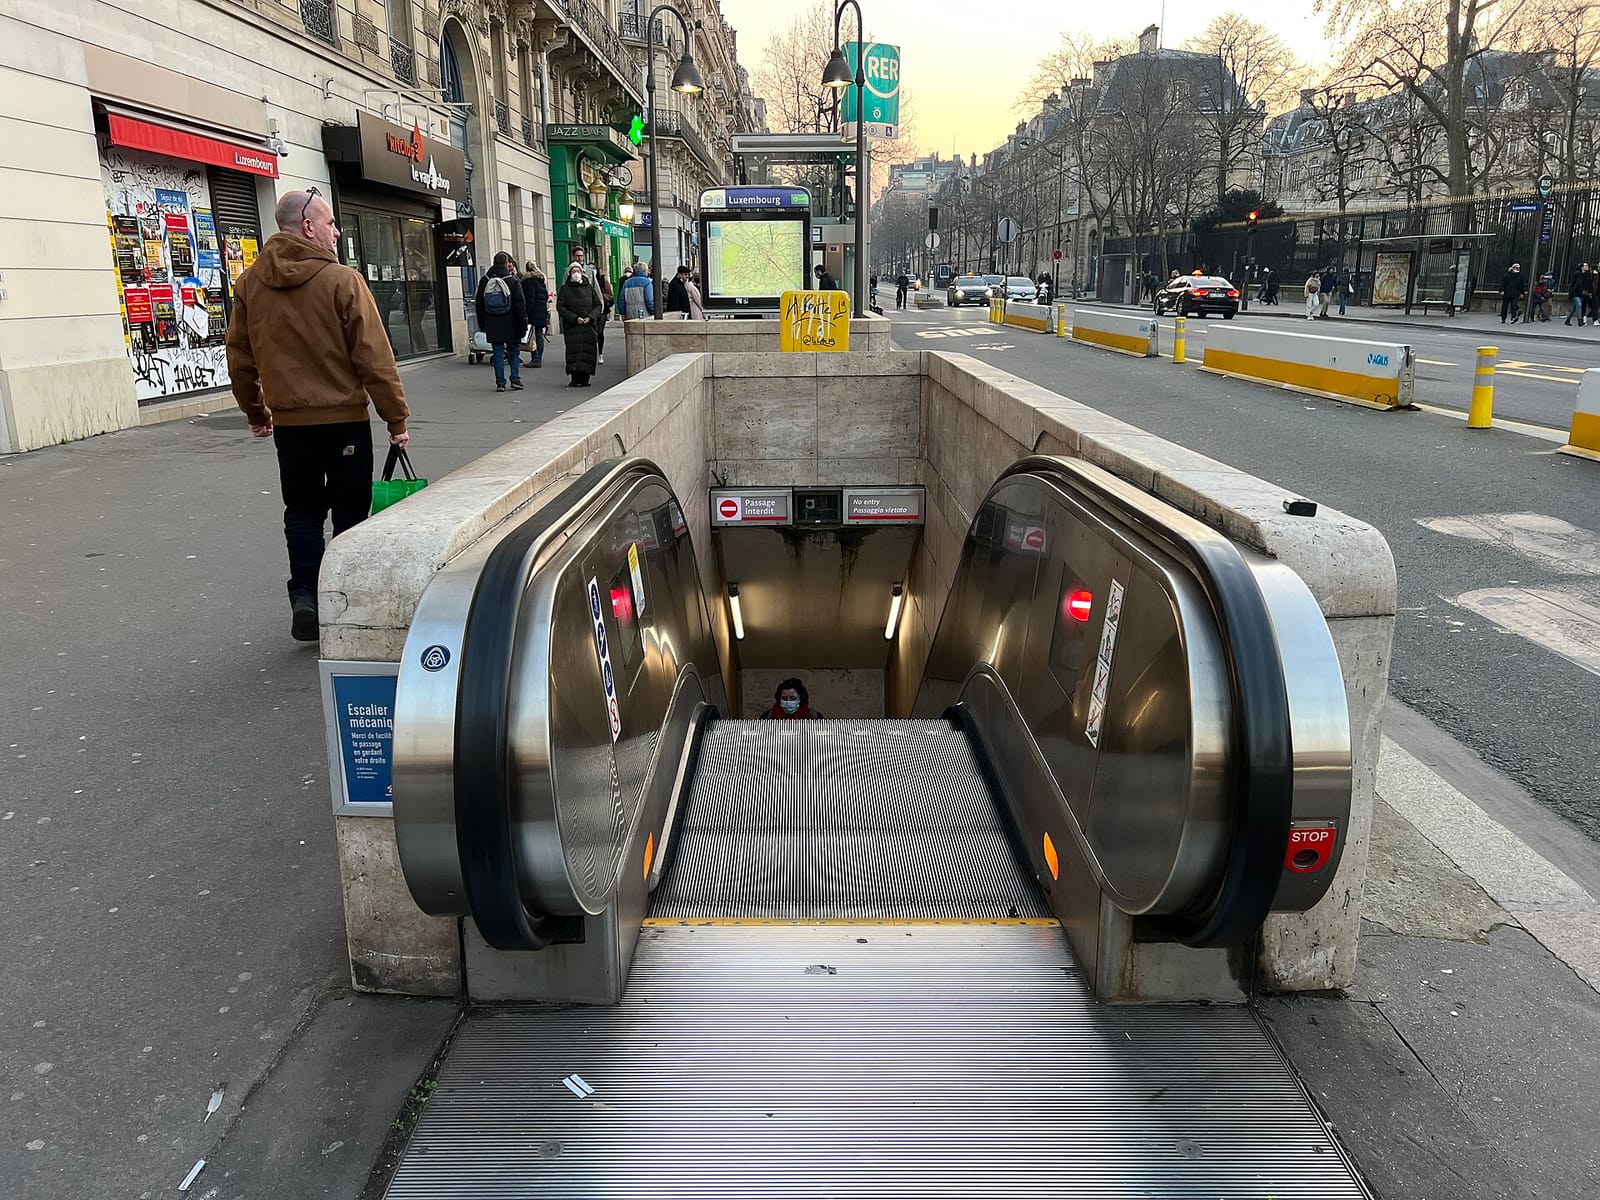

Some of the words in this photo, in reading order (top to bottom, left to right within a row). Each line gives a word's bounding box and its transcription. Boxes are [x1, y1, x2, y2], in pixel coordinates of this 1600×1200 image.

[868, 56, 898, 80] RER
[551, 127, 578, 136] JAZZ
[582, 127, 604, 136] BAR
[235, 151, 274, 175] Luxembourg
[411, 164, 419, 182] le
[437, 172, 450, 195] shop
[1541, 179, 1552, 187] BUS
[728, 196, 781, 206] Luxembourg
[745, 499, 776, 507] Passage
[745, 507, 774, 515] interdit
[347, 703, 388, 716] Escalier
[352, 740, 358, 748] le
[359, 741, 381, 749] passage
[361, 749, 383, 757] gardant
[1291, 831, 1329, 842] STOP
